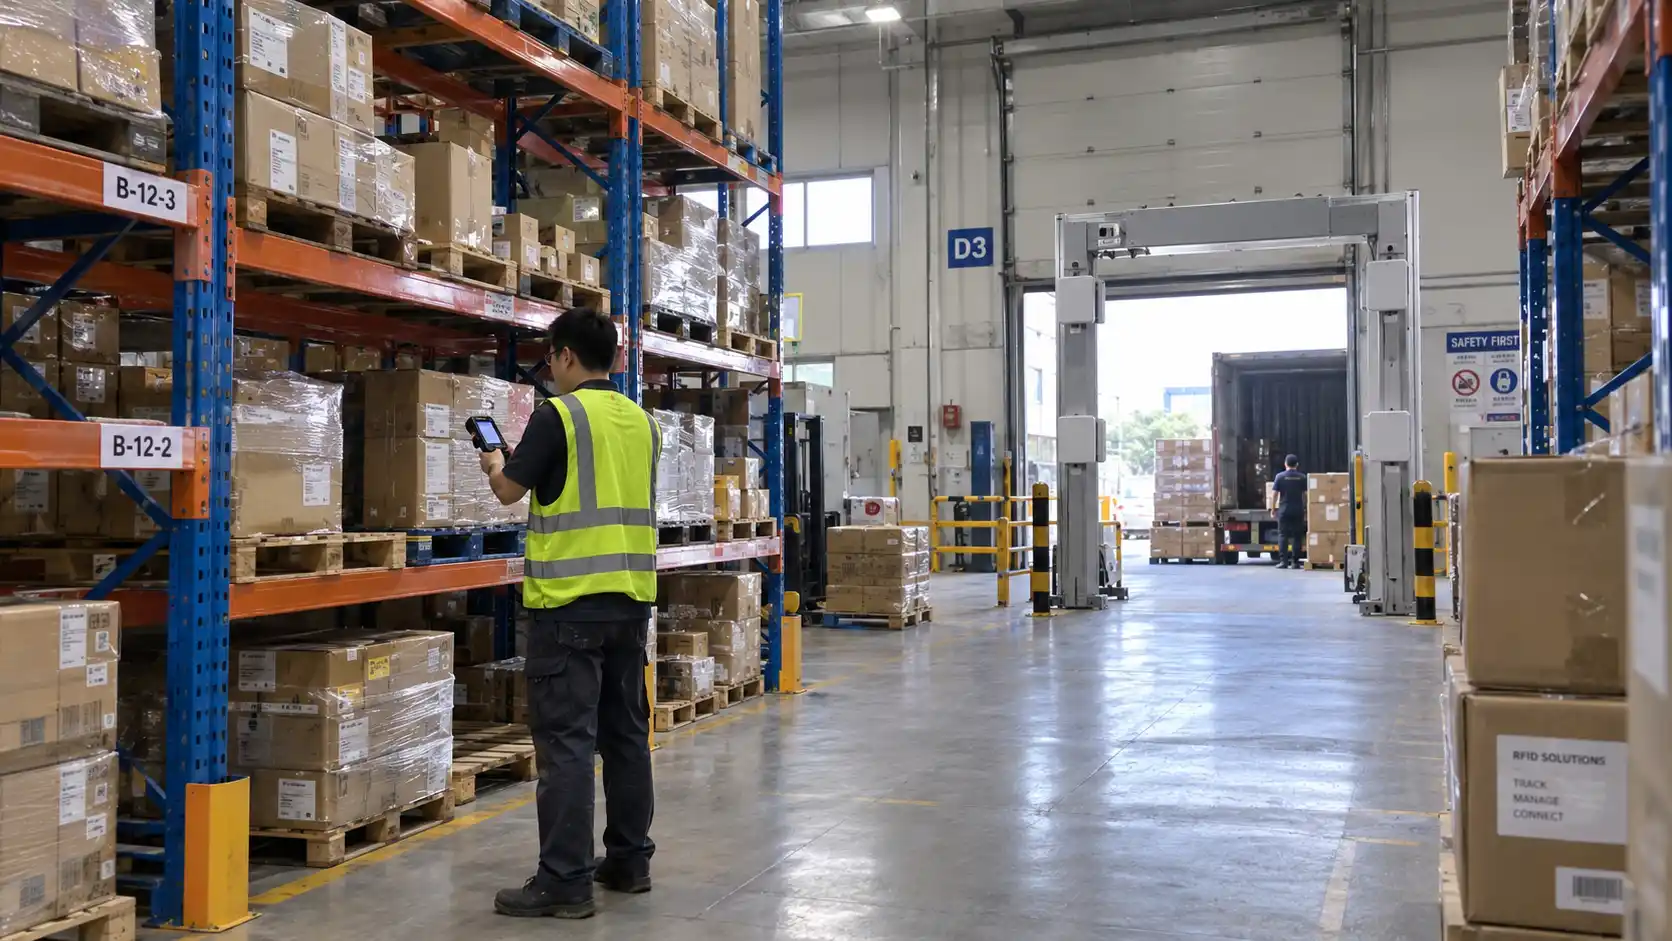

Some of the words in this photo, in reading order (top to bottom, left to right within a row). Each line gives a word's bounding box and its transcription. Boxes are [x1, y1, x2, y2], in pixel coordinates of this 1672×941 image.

[116, 176, 176, 210] B-12-3
[954, 236, 987, 260] D3
[1451, 336, 1488, 348] SAFETY
[1491, 335, 1519, 346] FIRST
[113, 435, 172, 458] B-12-2
[1512, 751, 1538, 762] RFID
[1541, 752, 1606, 765] SOLUTIONS
[1513, 779, 1547, 789] TRACK
[1513, 795, 1559, 806] MANAGE
[1514, 810, 1563, 821] CONNECT
